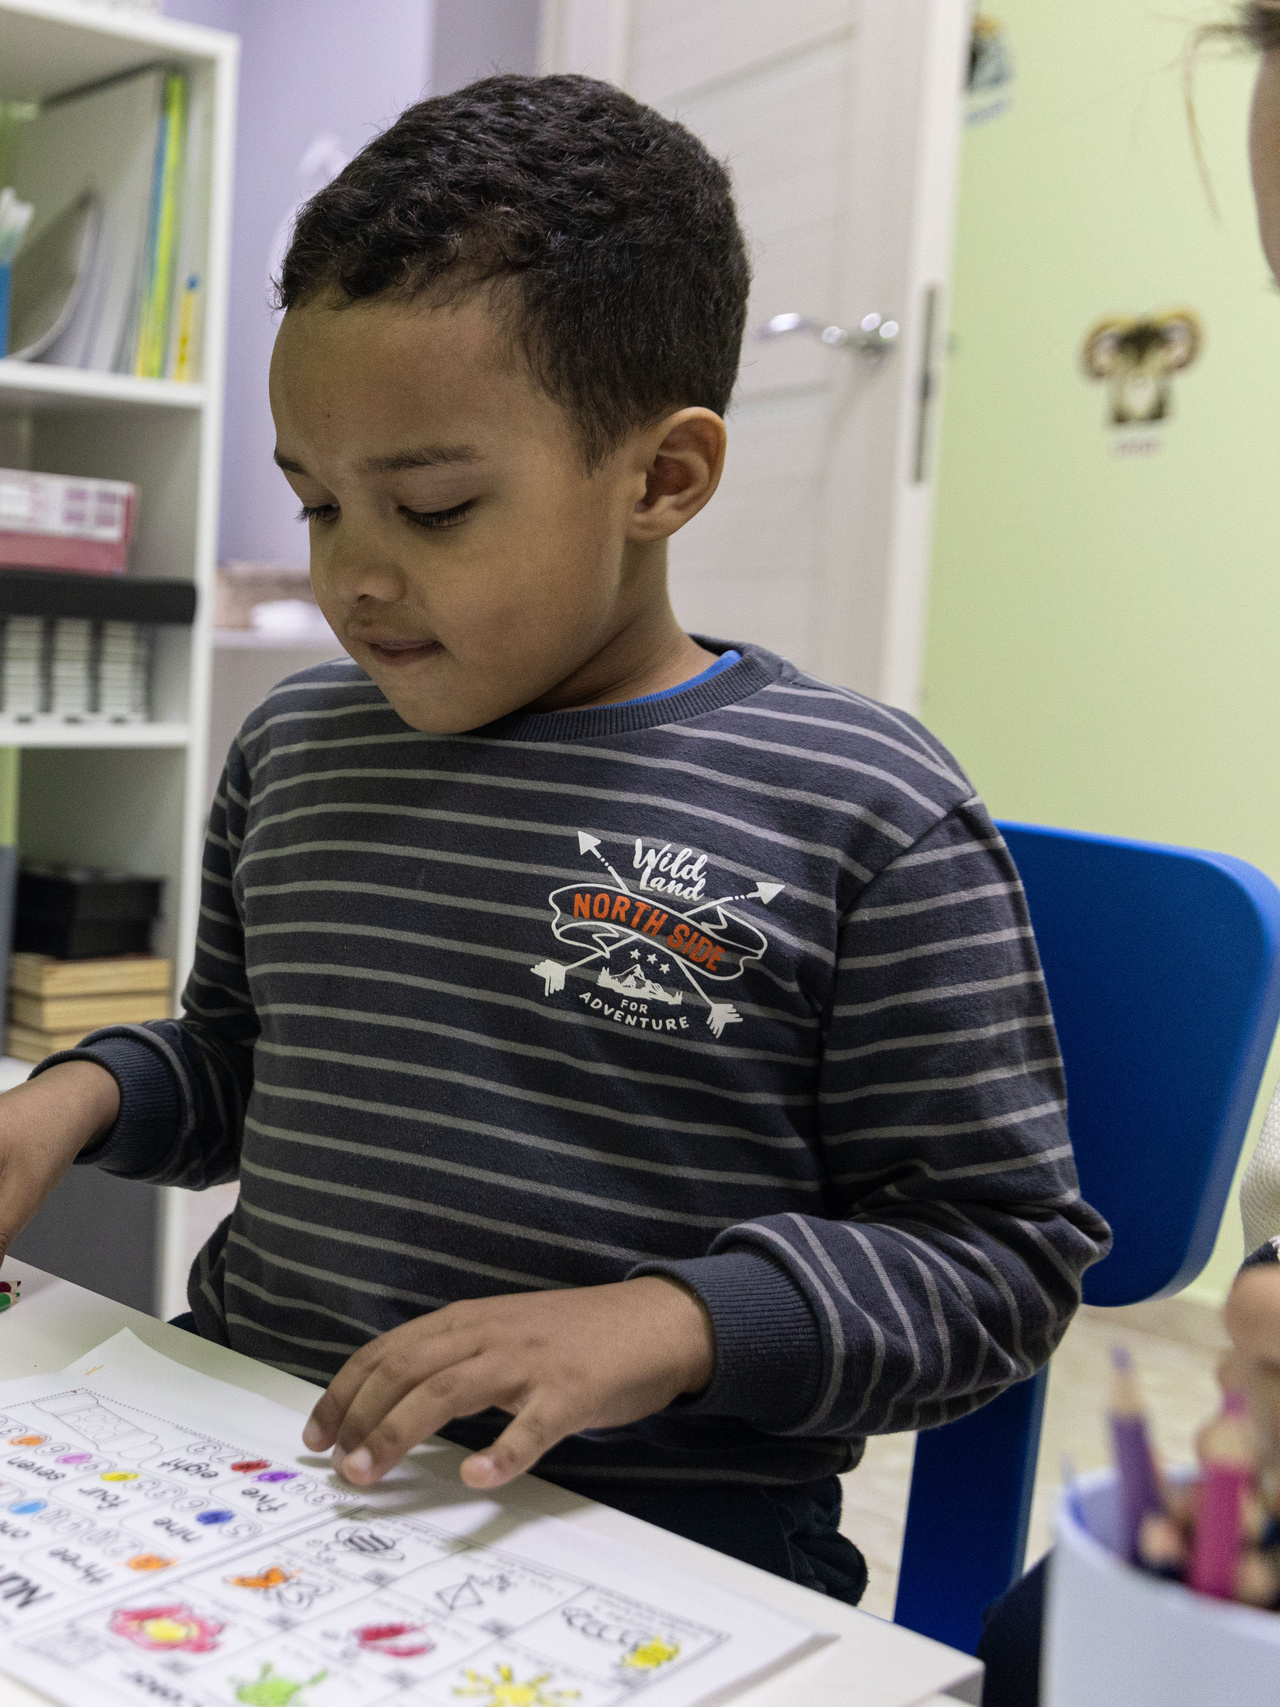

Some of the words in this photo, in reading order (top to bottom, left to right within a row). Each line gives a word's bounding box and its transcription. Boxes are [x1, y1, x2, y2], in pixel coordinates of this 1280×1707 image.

[632, 838, 708, 882] Wild
[639, 865, 706, 901] Land
[573, 893, 669, 937] NORTH
[666, 923, 727, 972] SIDE
[578, 991, 690, 1031] ADVENTURE
[620, 998, 649, 1014] FOR
[7, 1456, 66, 1481] seven
[157, 1457, 219, 1478] eight
[78, 1486, 130, 1511] four
[241, 1487, 289, 1513] five
[153, 1517, 205, 1543] nine
[48, 1546, 114, 1585] three
